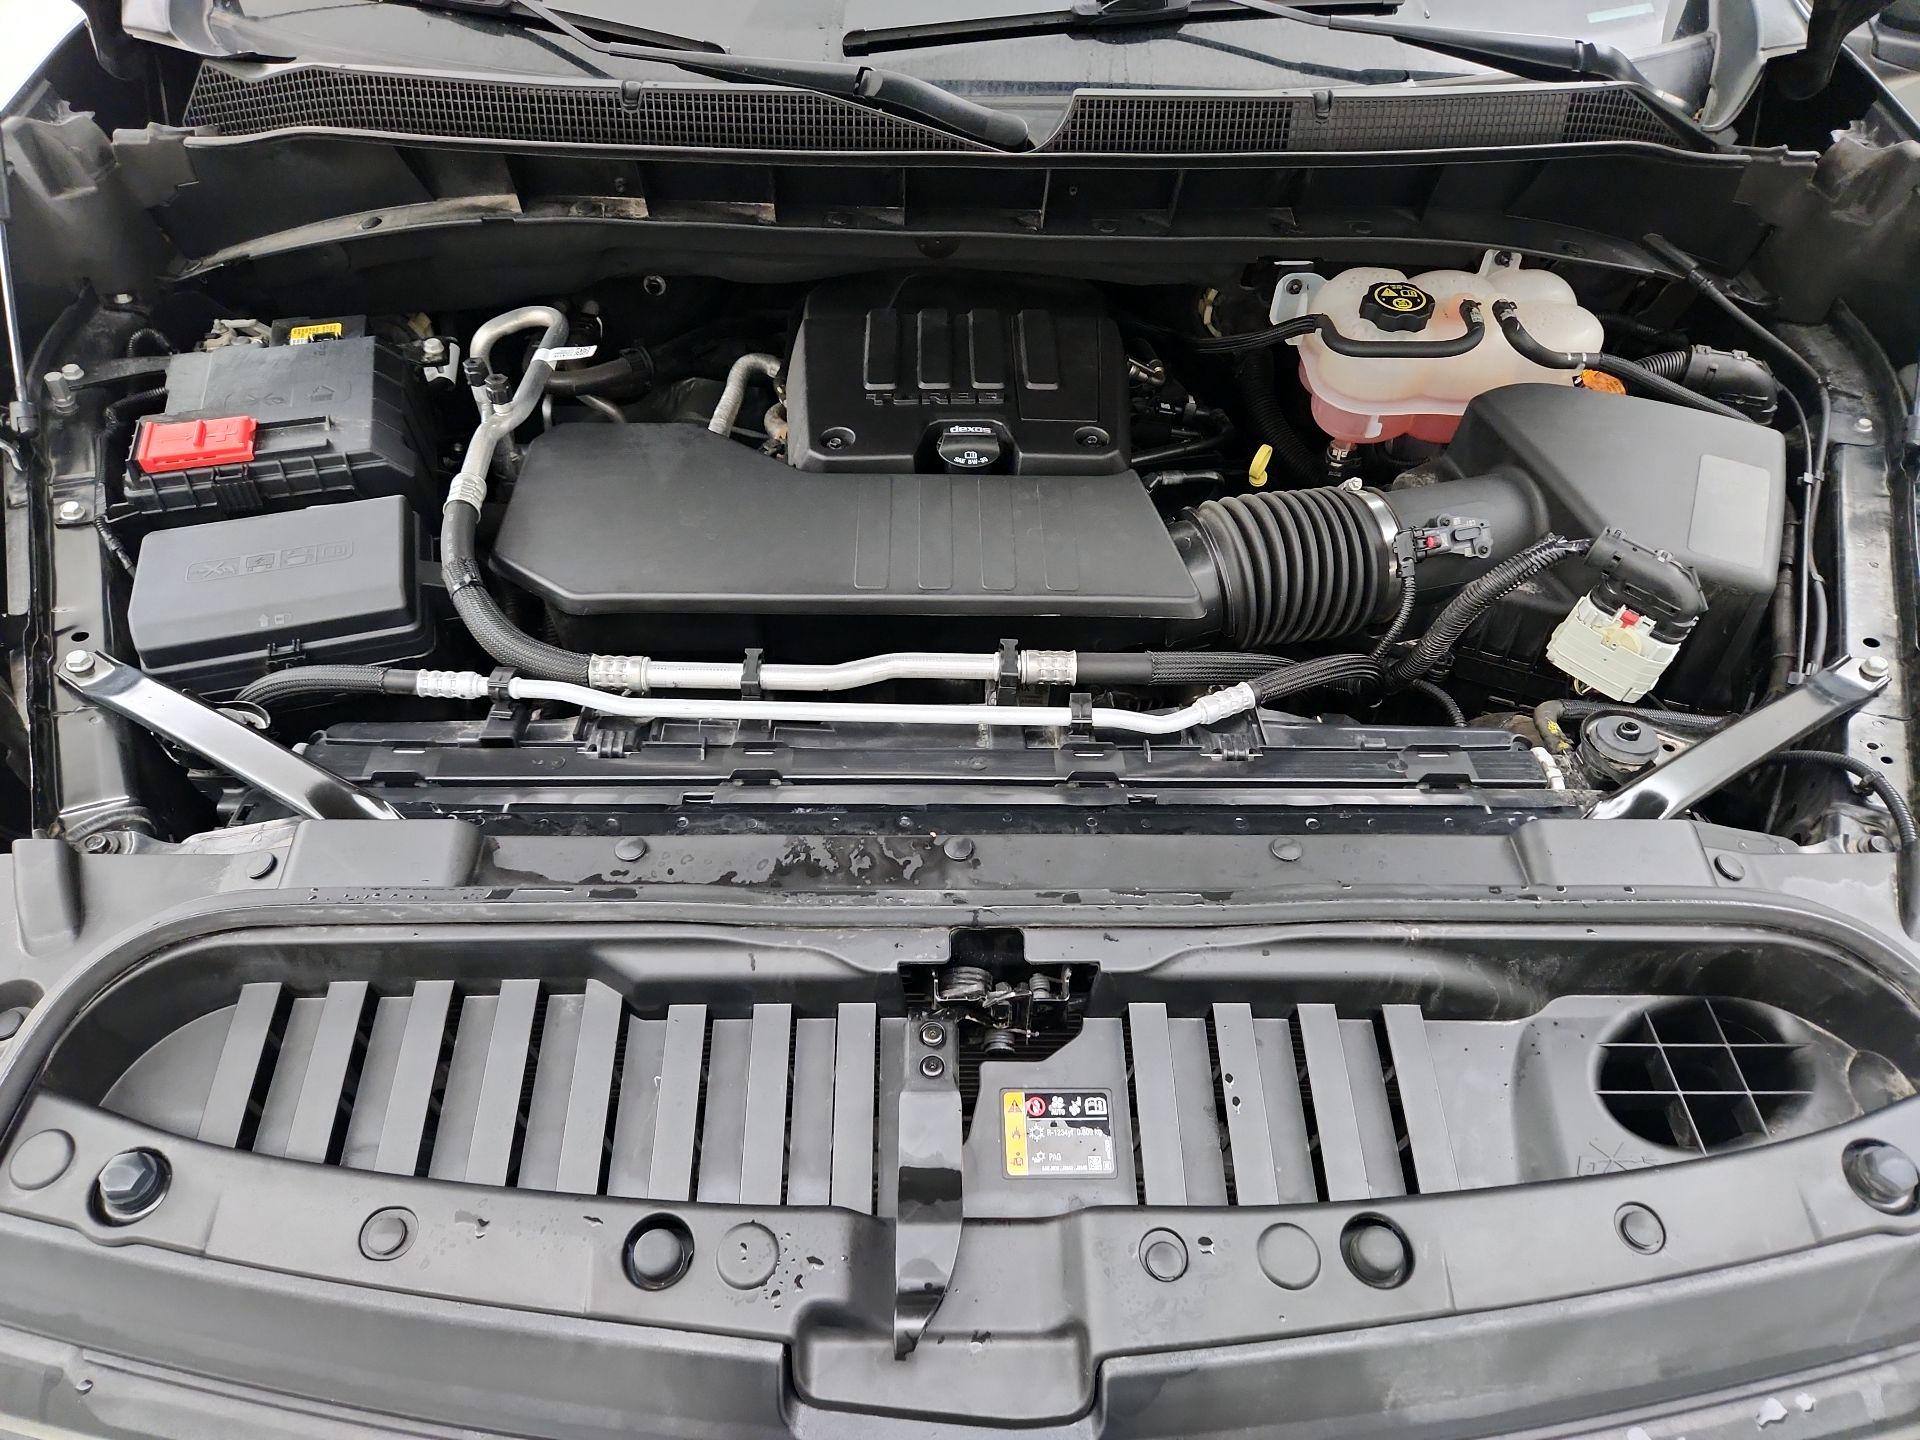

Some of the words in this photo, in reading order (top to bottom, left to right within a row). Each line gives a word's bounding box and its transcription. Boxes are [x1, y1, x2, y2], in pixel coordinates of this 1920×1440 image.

[866, 392, 1004, 406] TURBO
[949, 425, 991, 433] dexos
[953, 456, 966, 464] SAE
[1051, 1108, 1066, 1116] AUTO
[1048, 1152, 1062, 1161] PAG
